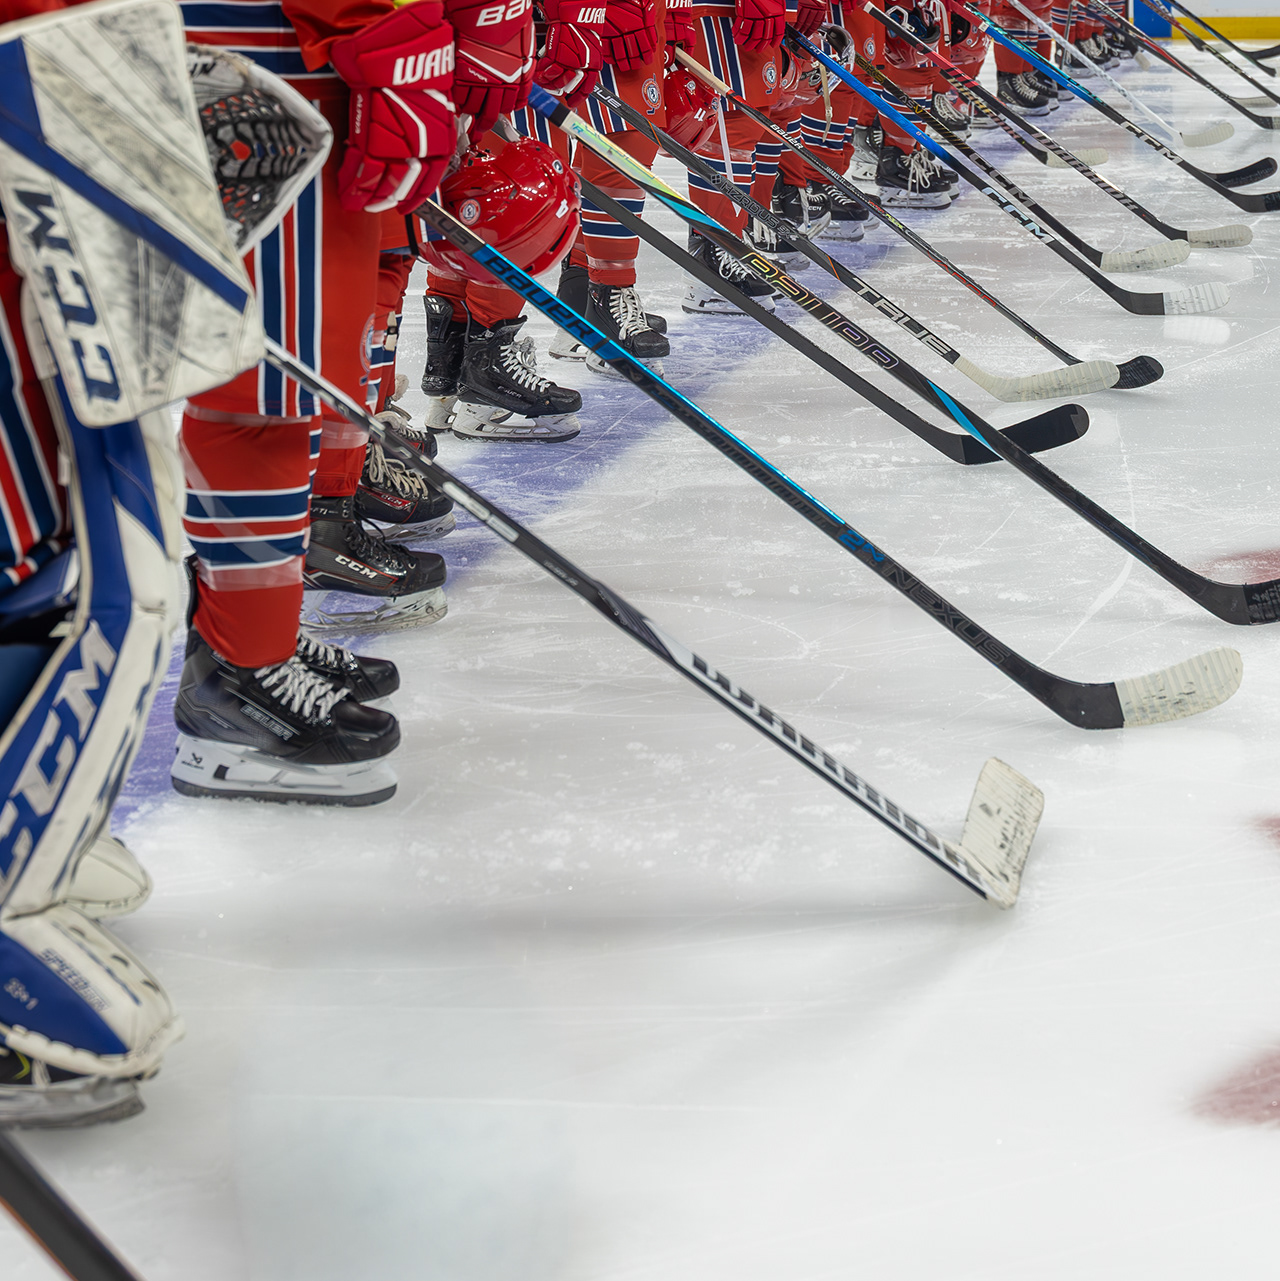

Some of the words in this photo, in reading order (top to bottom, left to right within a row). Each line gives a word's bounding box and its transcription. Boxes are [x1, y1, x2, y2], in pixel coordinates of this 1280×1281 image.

[1121, 121, 1183, 164] CCM
[970, 153, 1037, 207] CCM
[981, 187, 1055, 242] CCM
[14, 189, 122, 402] CCM
[853, 277, 952, 357] TRUE
[335, 554, 377, 579] CCM
[882, 567, 1011, 665] NEXUS
